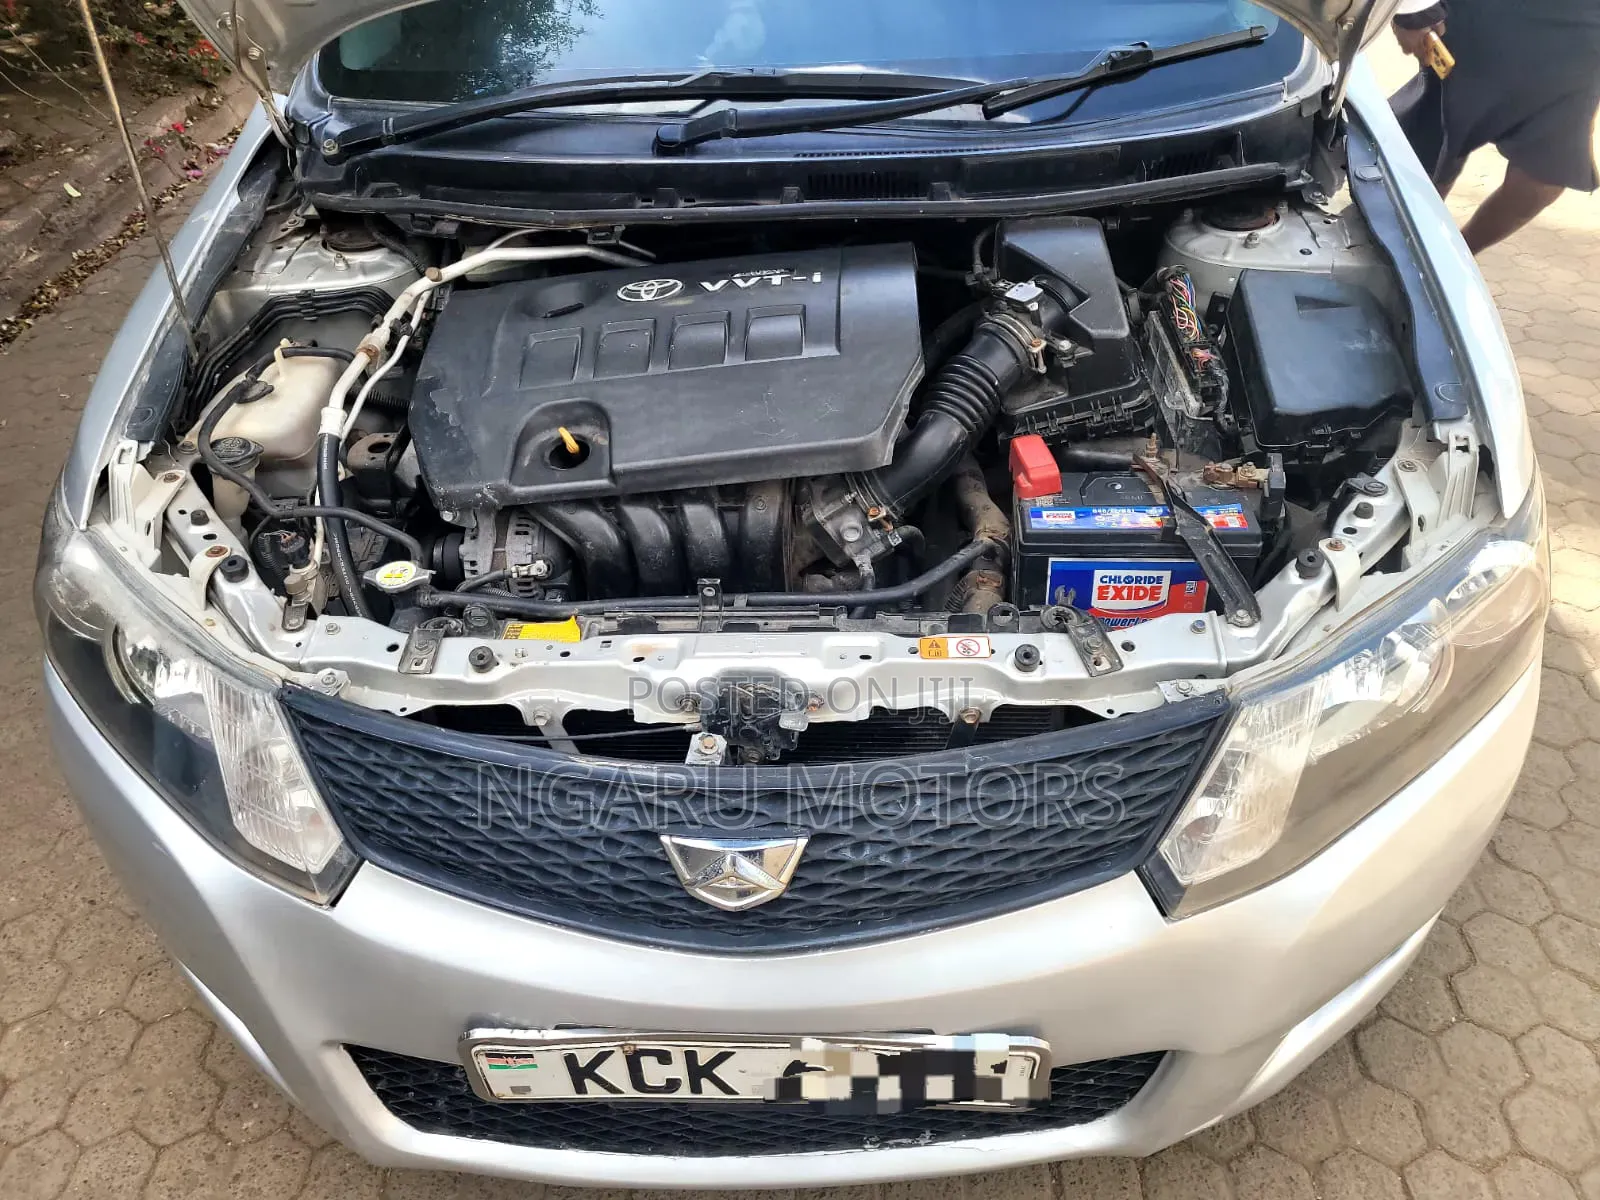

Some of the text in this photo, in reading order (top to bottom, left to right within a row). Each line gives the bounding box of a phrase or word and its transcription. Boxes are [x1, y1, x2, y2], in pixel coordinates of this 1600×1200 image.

[699, 271, 822, 292] VVT-i
[1099, 575, 1164, 585] CHLORIDE
[1097, 585, 1163, 601] EXIDE
[563, 1048, 741, 1095] KCK
